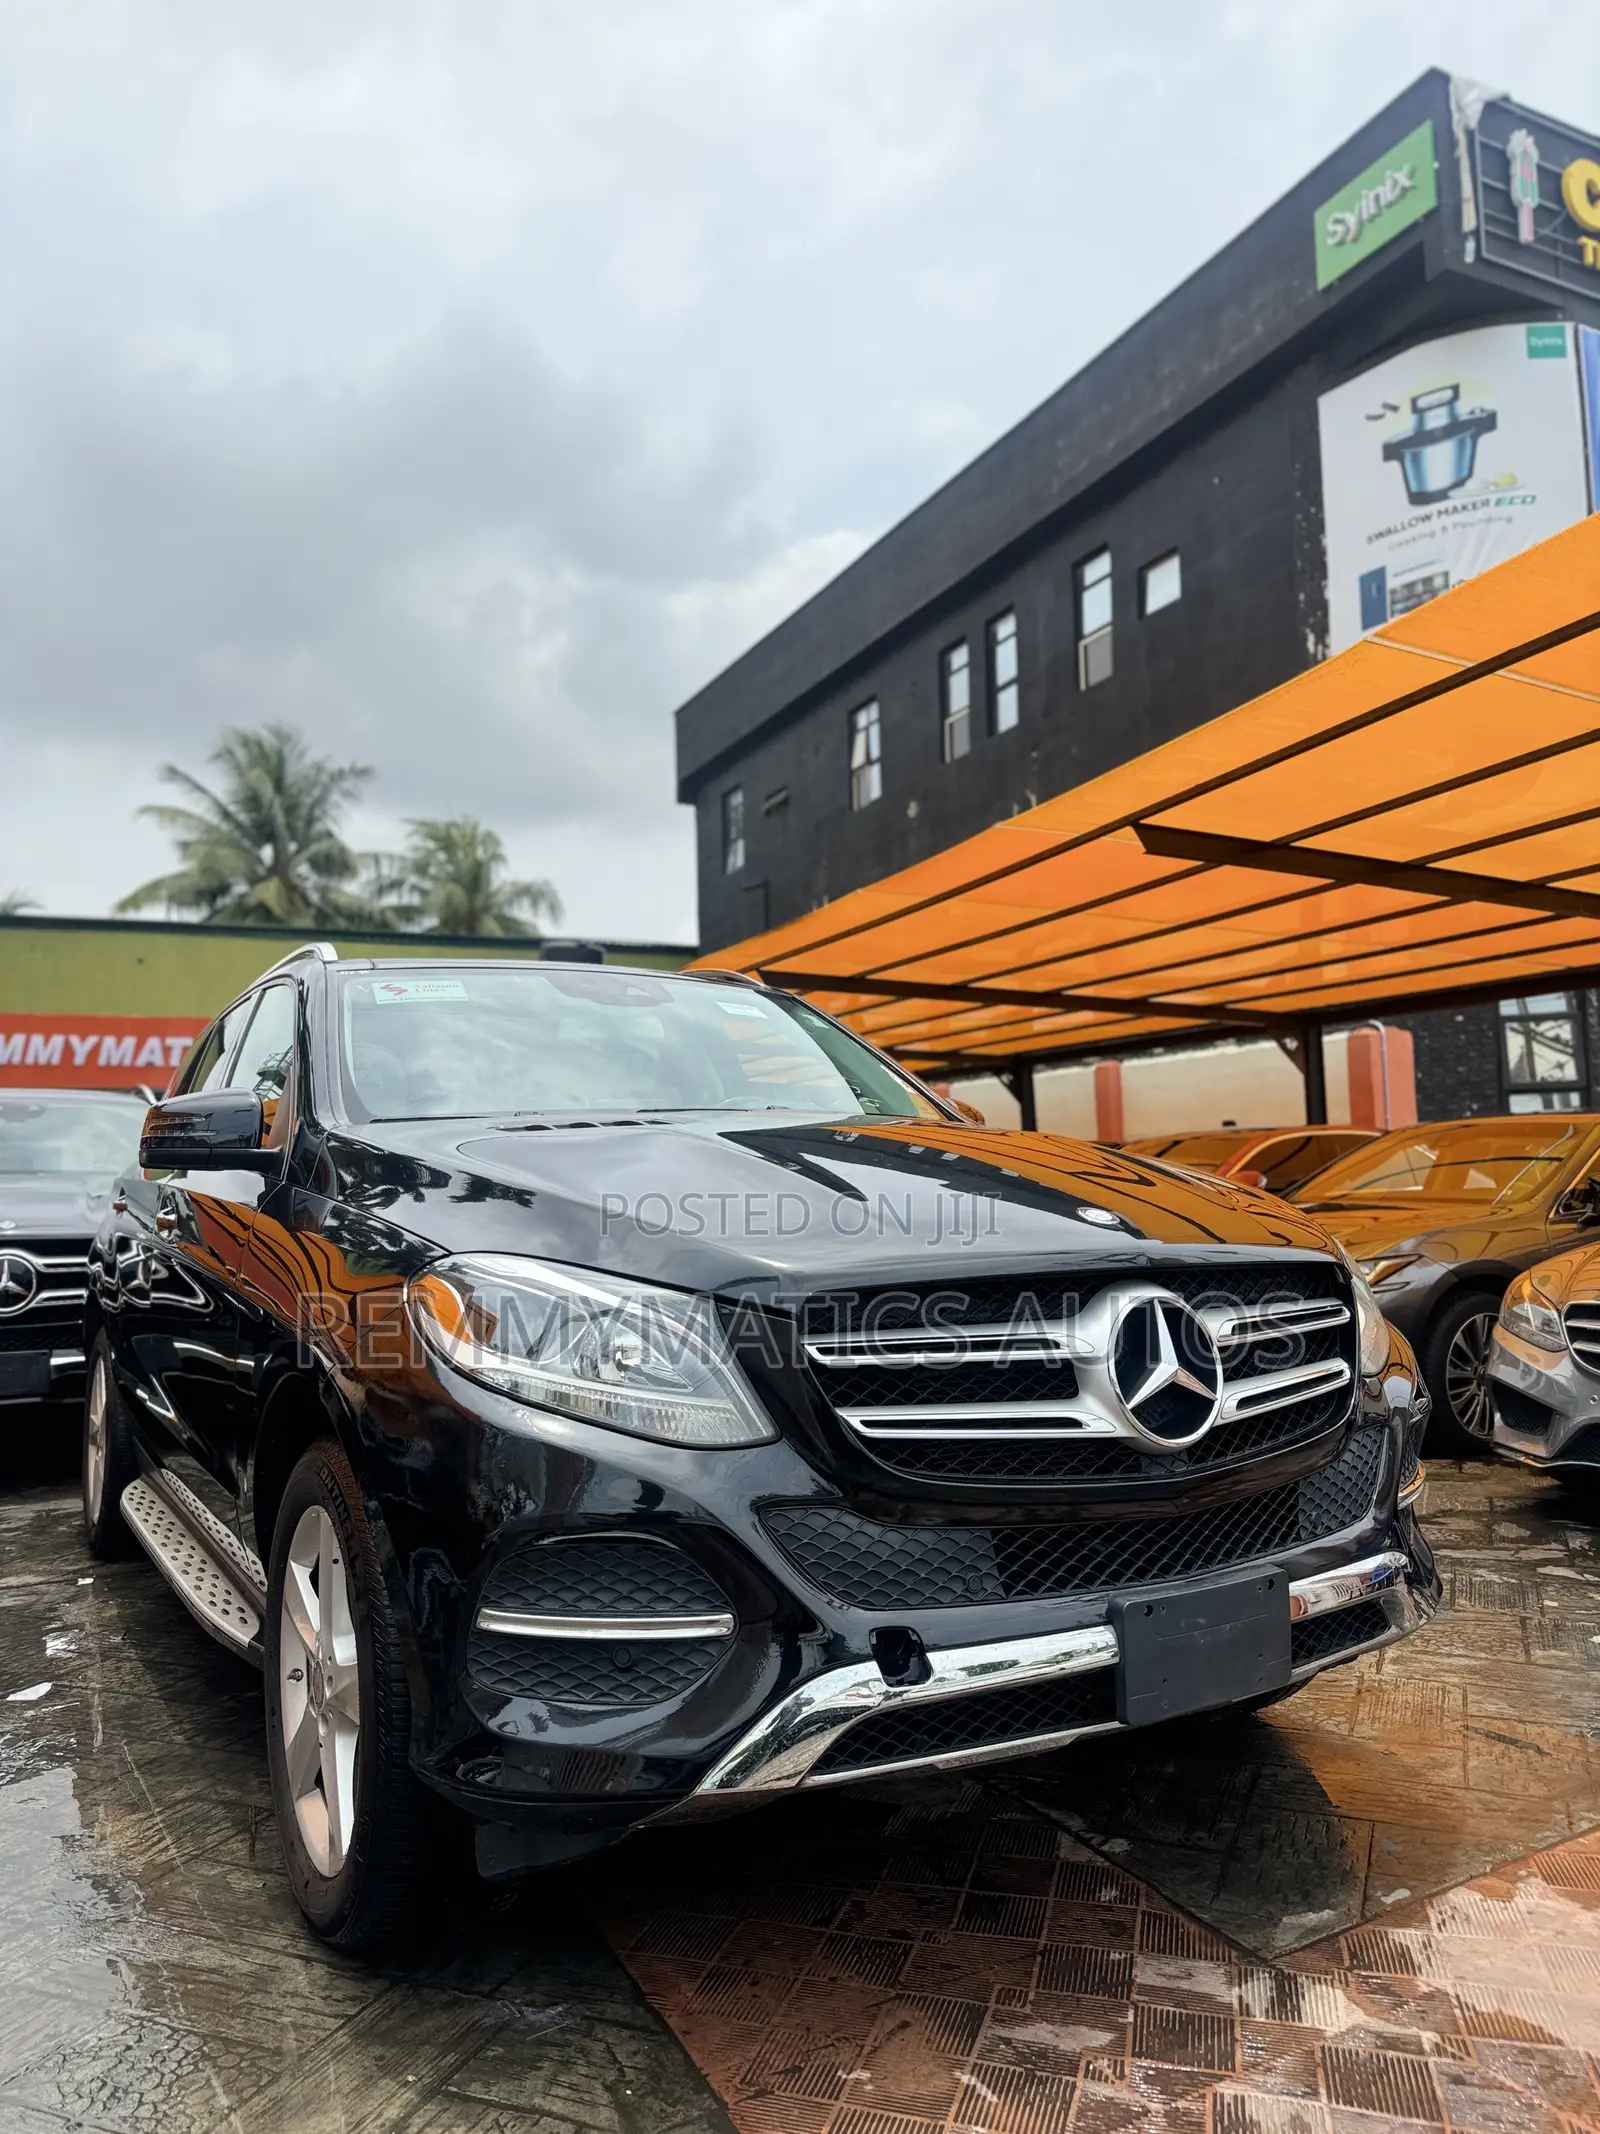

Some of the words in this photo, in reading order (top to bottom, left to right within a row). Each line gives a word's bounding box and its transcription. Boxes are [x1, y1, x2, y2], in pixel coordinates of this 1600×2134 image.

[1366, 511, 1434, 546] SWALLOW
[1436, 498, 1491, 521] MAKER
[1494, 494, 1538, 508] ECO
